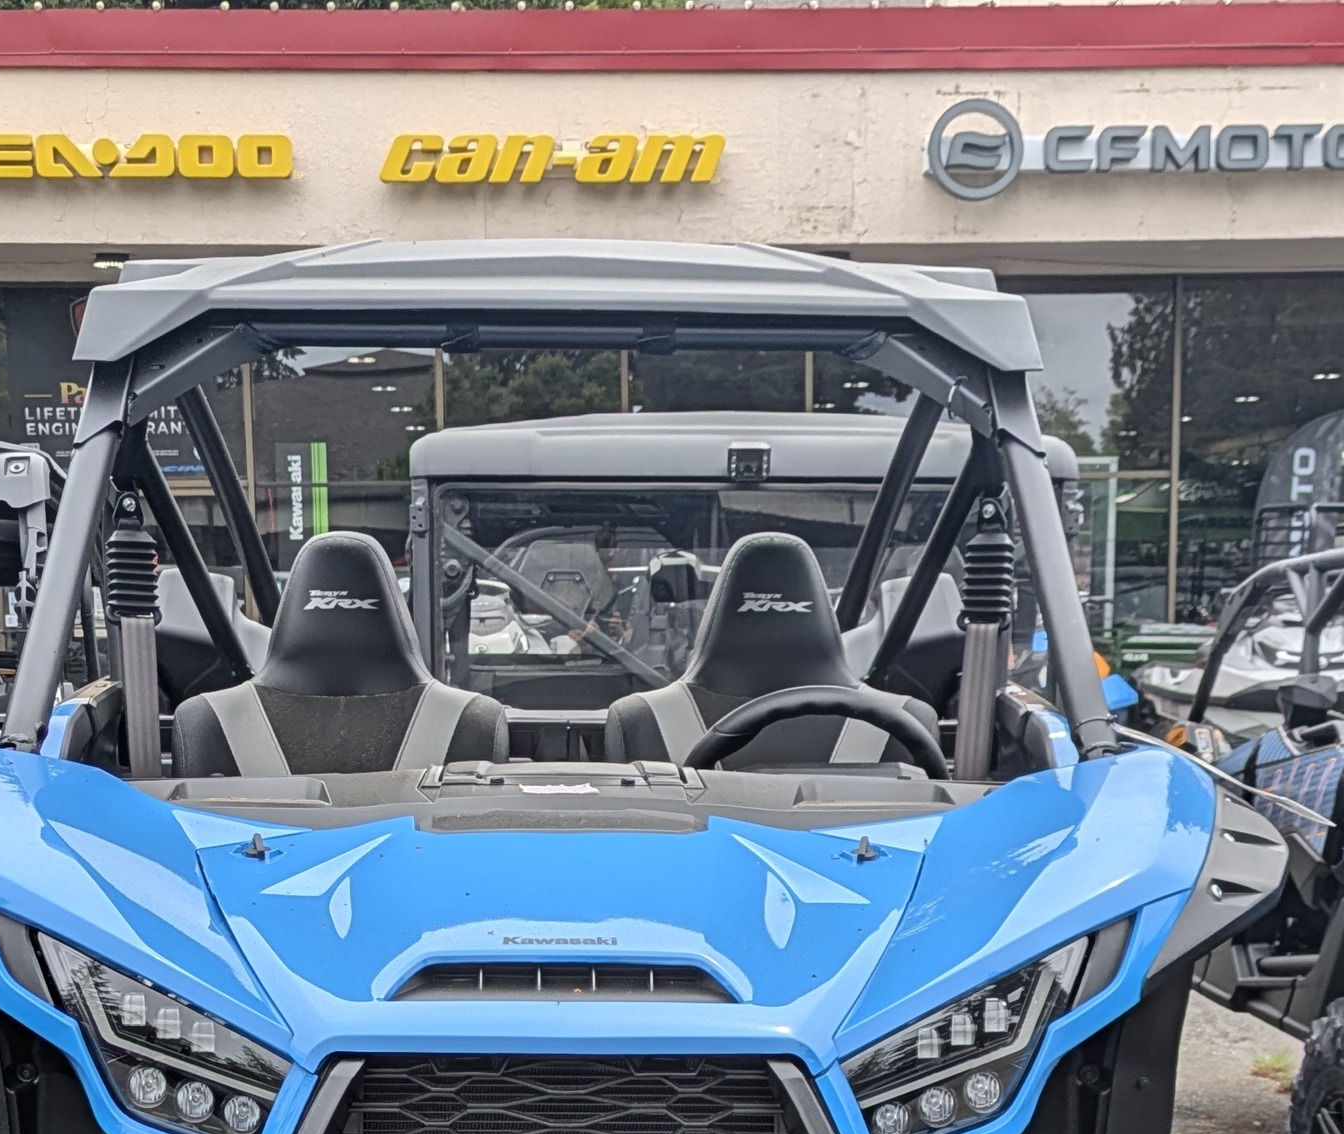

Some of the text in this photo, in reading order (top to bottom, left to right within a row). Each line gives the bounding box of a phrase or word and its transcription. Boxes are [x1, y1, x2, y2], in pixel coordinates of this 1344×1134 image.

[303, 597, 380, 610] KRX
[737, 600, 814, 612] KRX
[502, 936, 618, 946] Kawasaki
